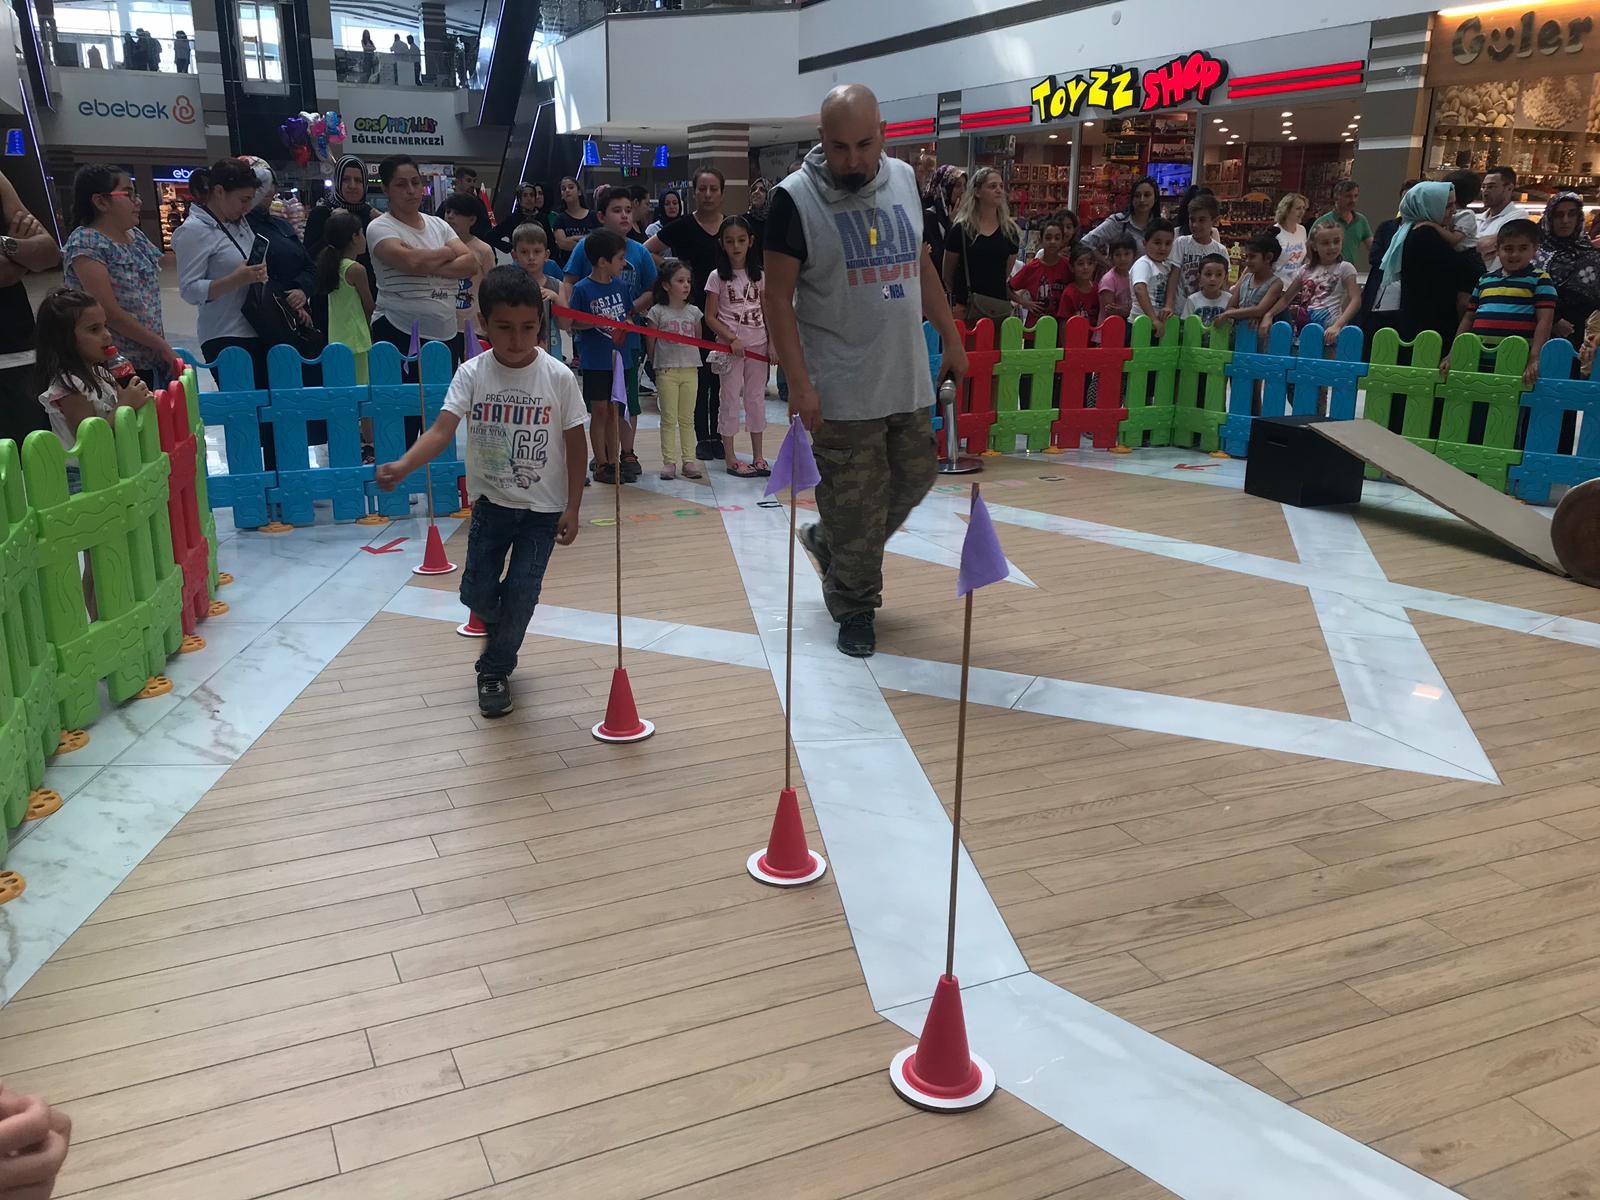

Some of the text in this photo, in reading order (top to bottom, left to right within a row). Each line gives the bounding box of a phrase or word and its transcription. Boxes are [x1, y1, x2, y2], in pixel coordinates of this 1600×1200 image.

[1452, 11, 1593, 64] Güler
[1139, 50, 1229, 112] SHOP
[78, 99, 169, 119] ebebek
[351, 134, 445, 146] EĞLENCE MERKEZİ
[889, 283, 905, 299] NBA
[485, 393, 543, 406] PREVALENT
[472, 402, 551, 425] STATUTES
[512, 429, 549, 461] 62
